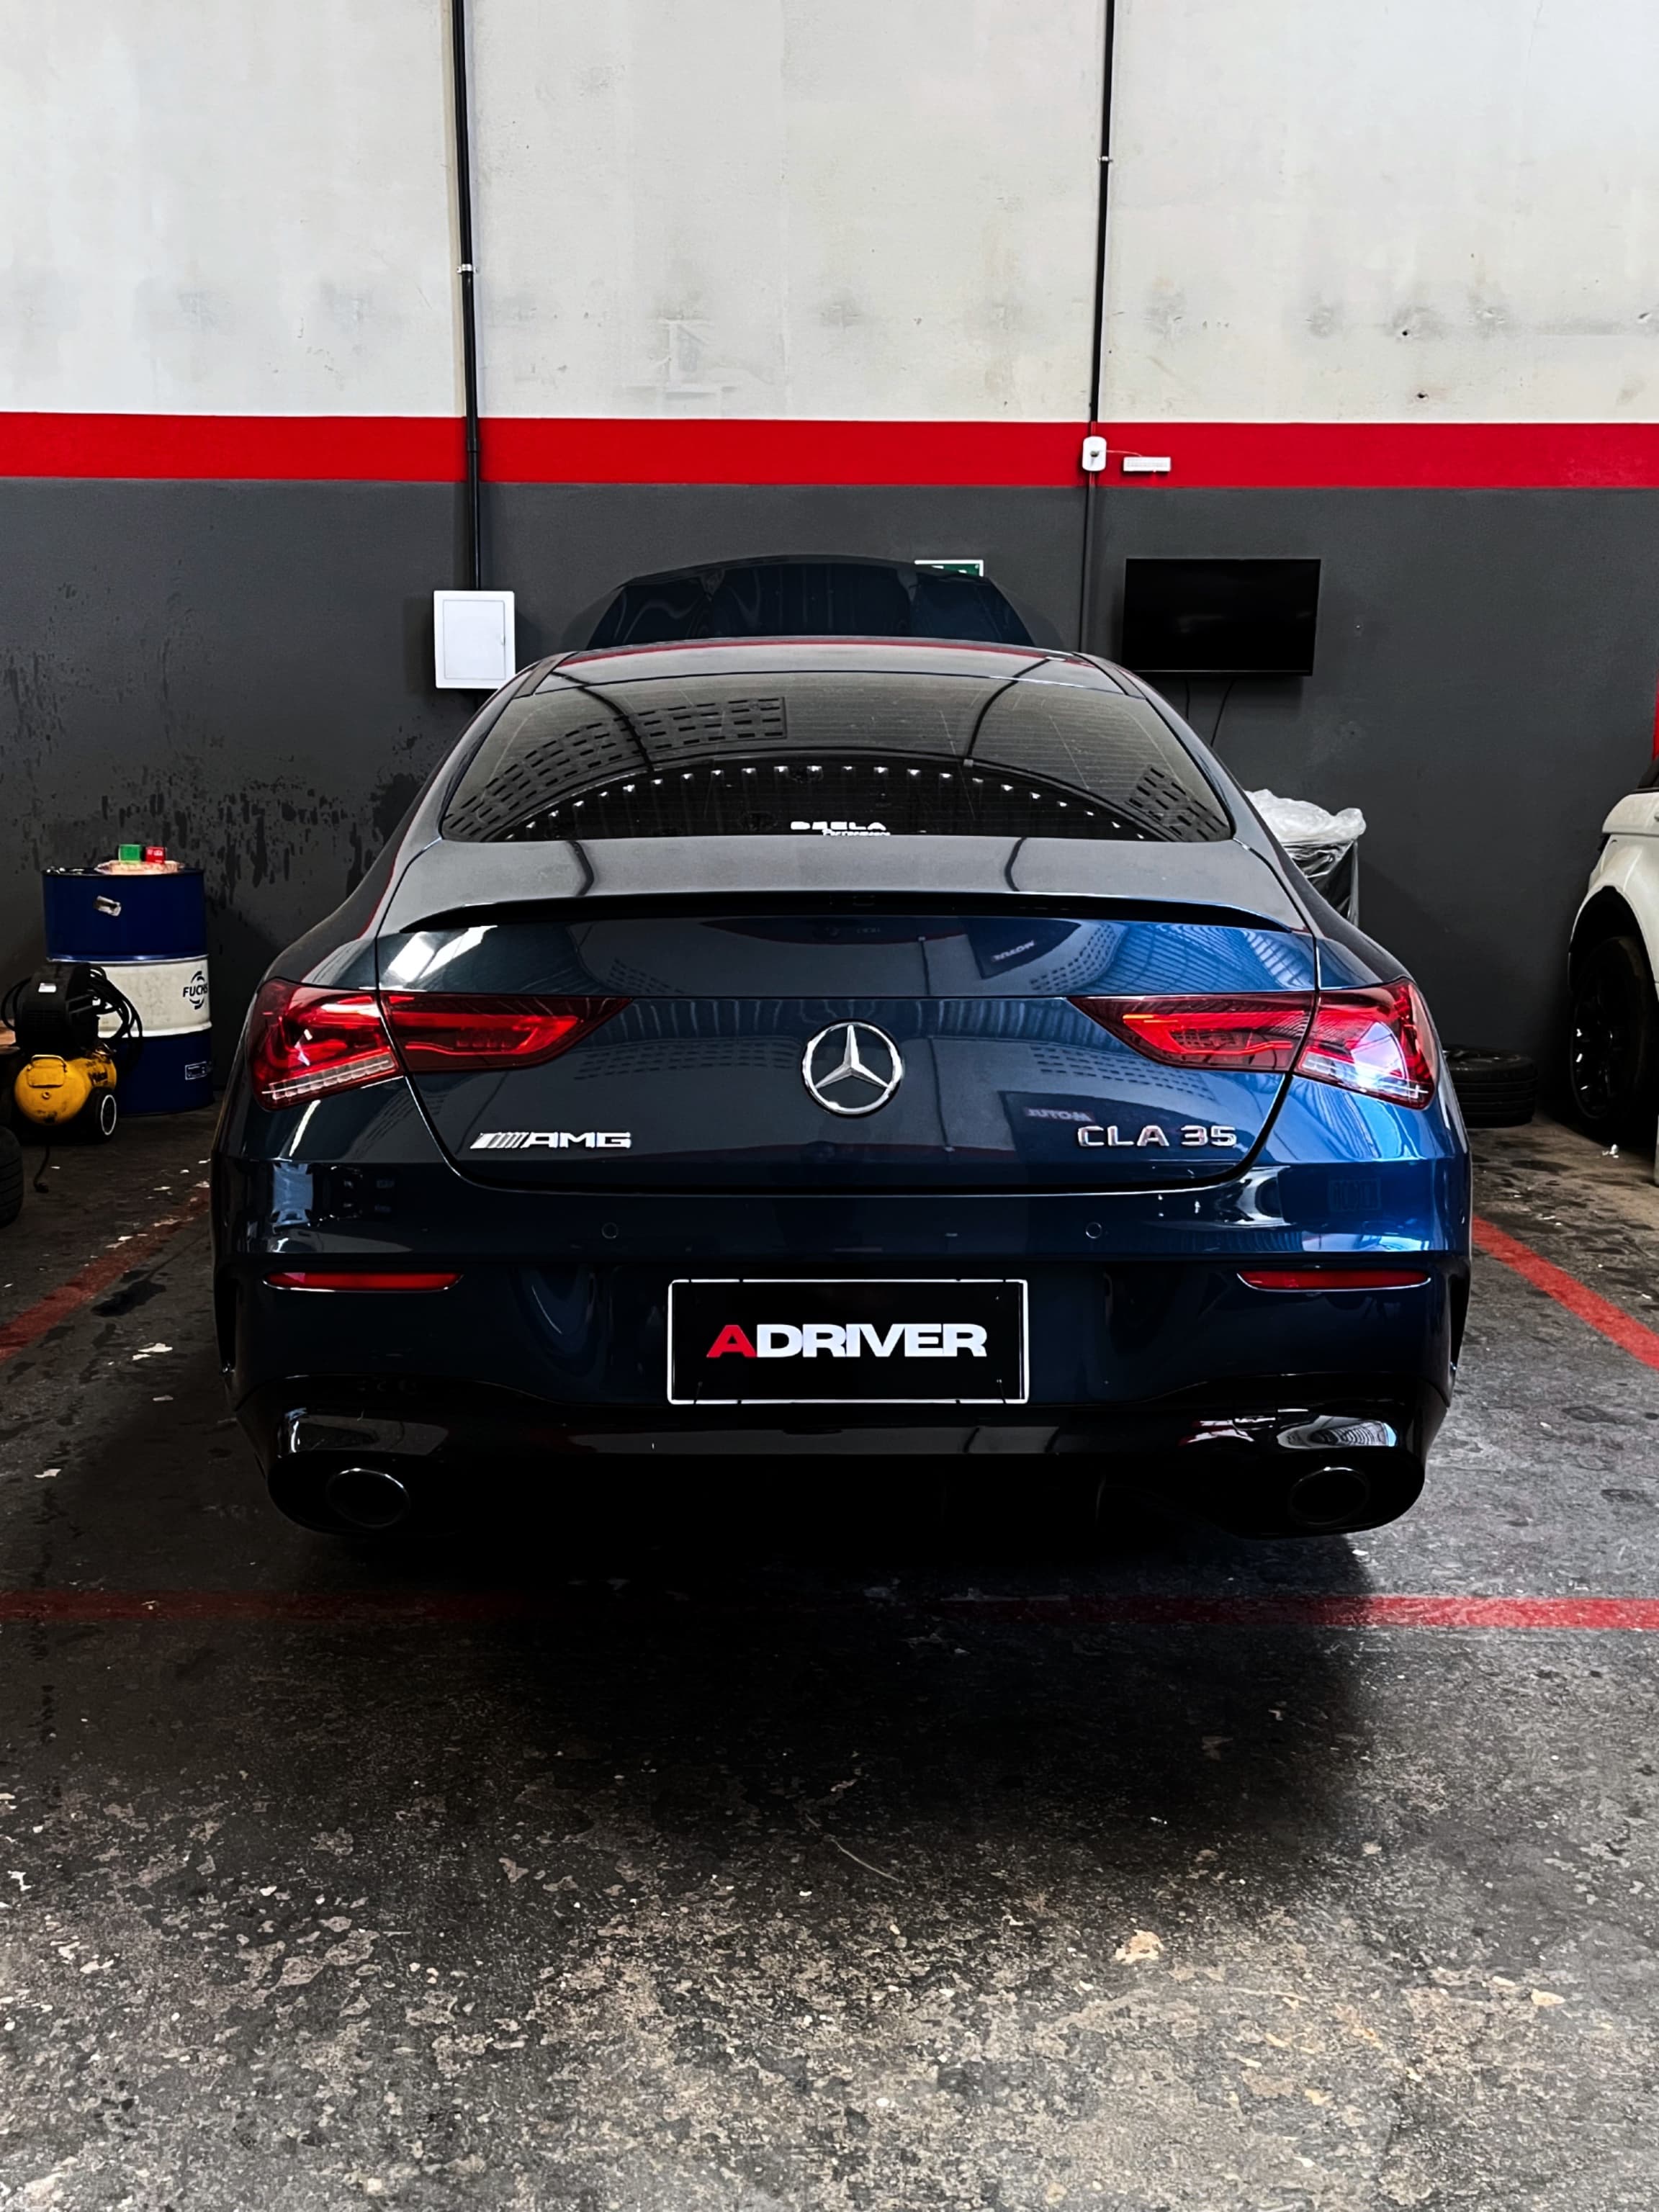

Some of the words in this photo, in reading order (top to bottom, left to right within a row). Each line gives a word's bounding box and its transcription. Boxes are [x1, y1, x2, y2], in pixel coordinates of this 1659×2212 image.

[183, 983, 208, 997] FUCHS
[520, 1131, 631, 1148] AMG
[1077, 1125, 1169, 1147] CLA
[1180, 1125, 1237, 1147] 35
[706, 1323, 987, 1357] ADRIVER
